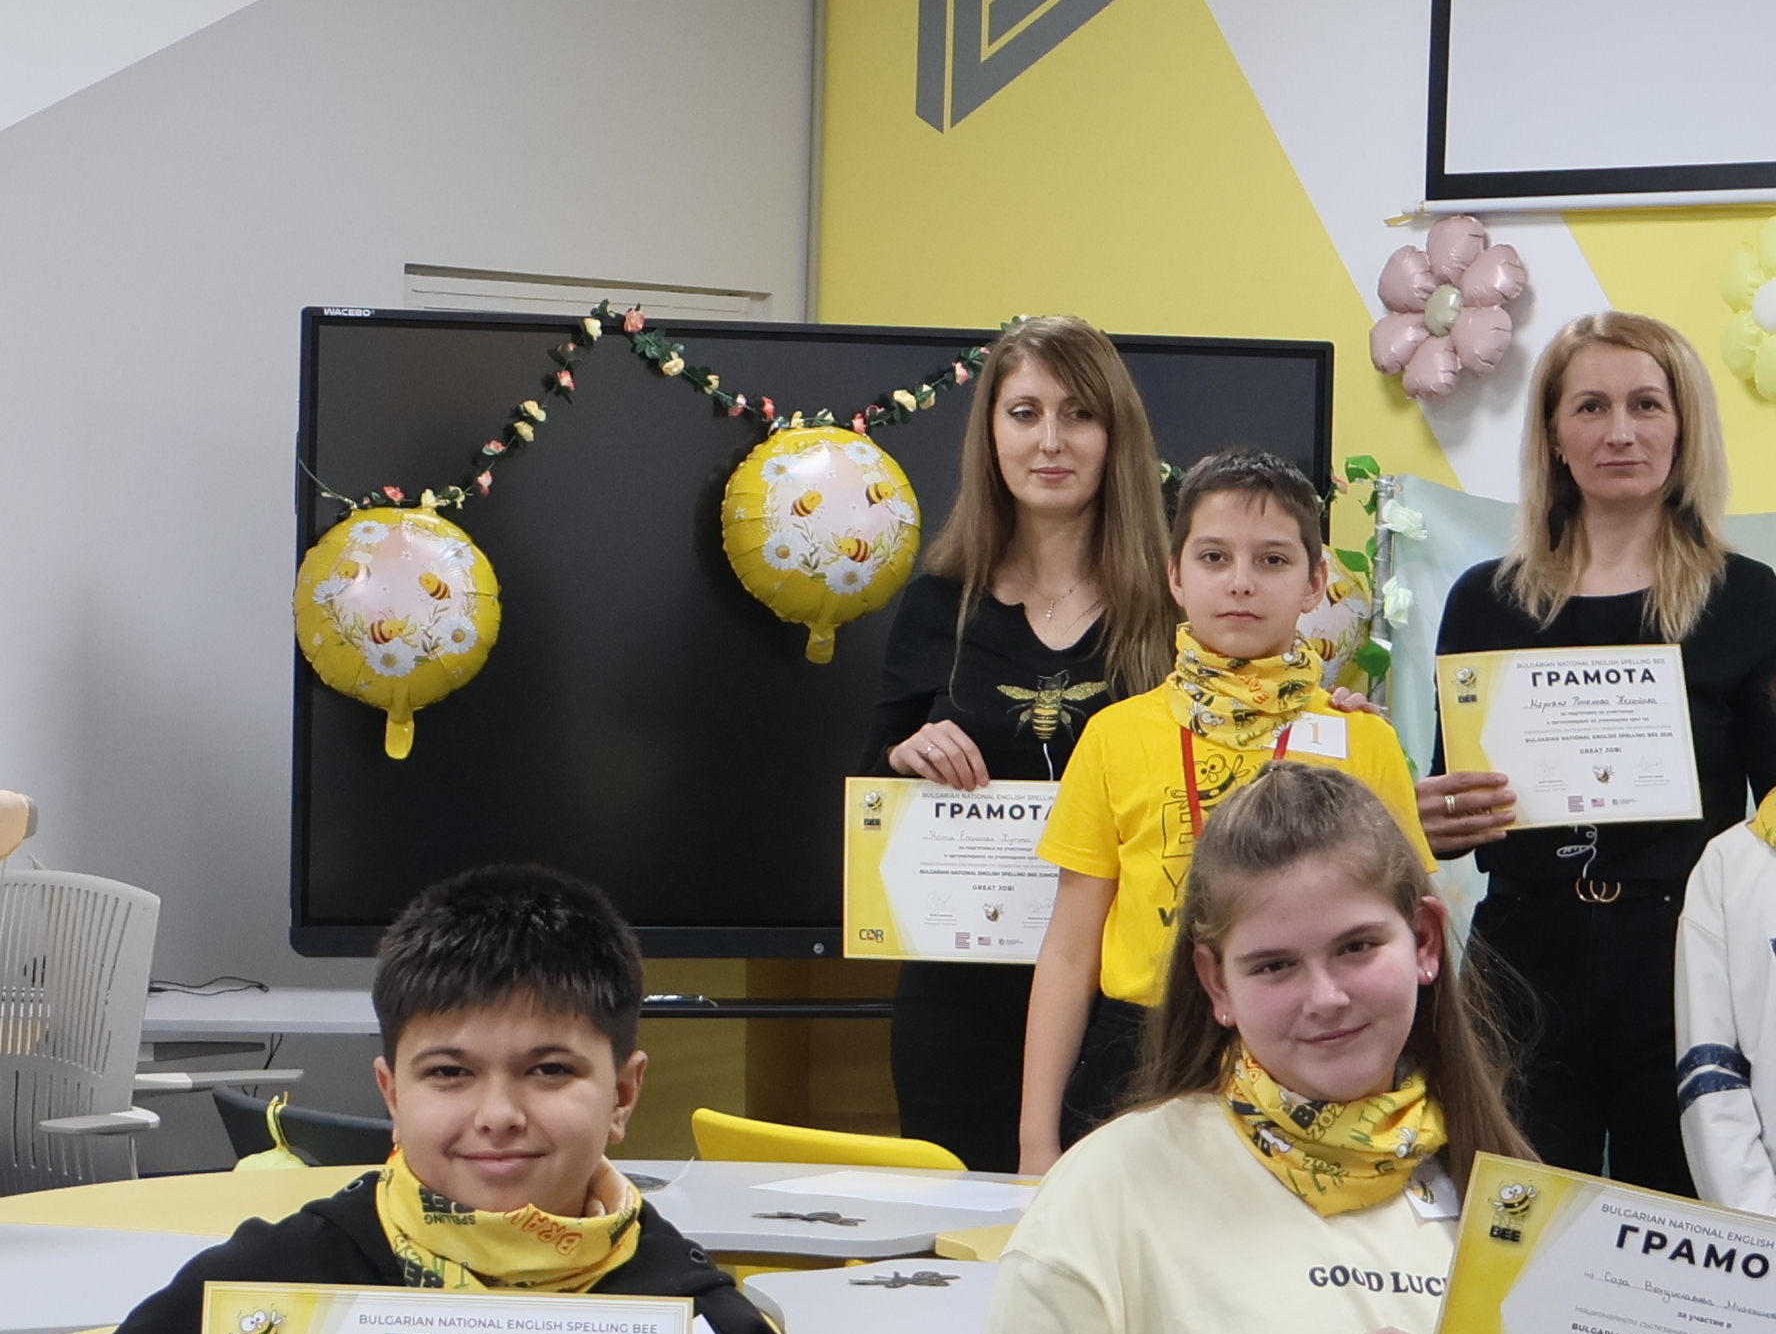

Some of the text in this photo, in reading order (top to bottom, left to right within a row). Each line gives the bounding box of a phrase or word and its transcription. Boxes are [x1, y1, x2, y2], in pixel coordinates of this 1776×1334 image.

[1531, 668, 1656, 687] ГРАМОТА
[1488, 1226, 1522, 1244] BEE
[1601, 1204, 1666, 1225] BULGARIAN
[1668, 1219, 1725, 1238] NATIONAL
[1727, 1232, 1775, 1249] ENGLISH
[1309, 1264, 1448, 1297] GOOD LUC
[359, 1314, 657, 1334] BULGARIAN NATIONAL ENGLISH SPELLING BEE
